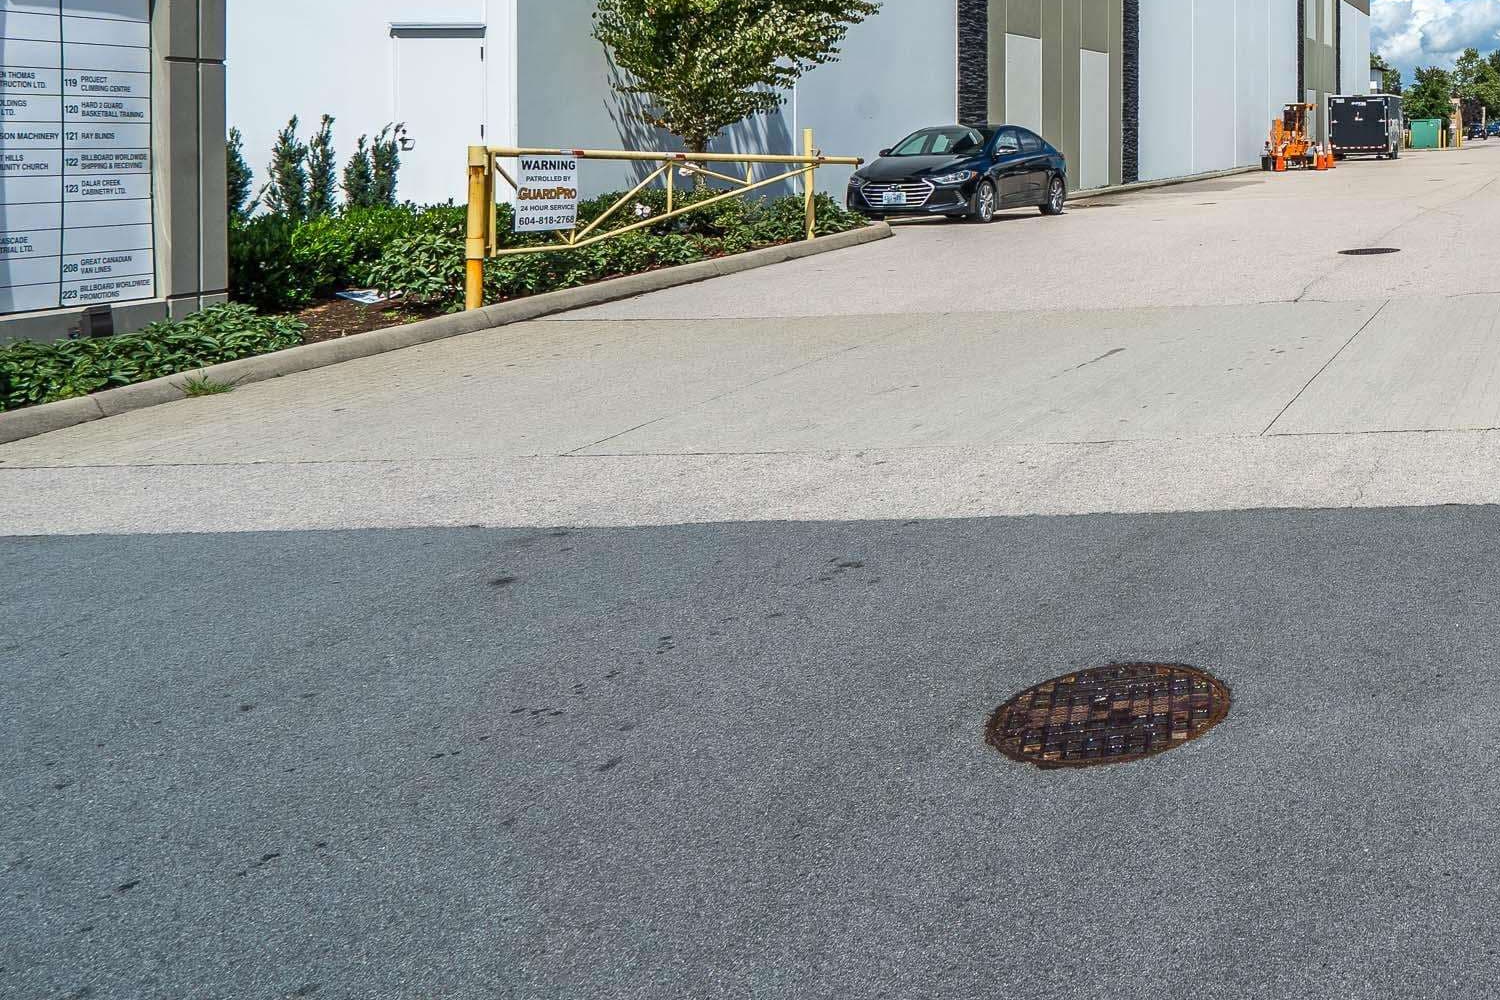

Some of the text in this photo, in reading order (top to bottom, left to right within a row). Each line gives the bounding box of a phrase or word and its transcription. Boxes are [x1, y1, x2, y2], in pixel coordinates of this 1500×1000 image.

[64, 76, 107, 87] 119 PROJECT
[65, 105, 78, 114] 120
[65, 132, 78, 140] 121
[65, 158, 78, 166] 122
[521, 160, 576, 170] WARNING
[65, 184, 78, 193] 123
[64, 256, 132, 272] 208 GREAT CANADIAN
[63, 279, 150, 299] 223 BILLBOARD WORLDWIDE
[80, 291, 120, 300] PROMOTIONS
